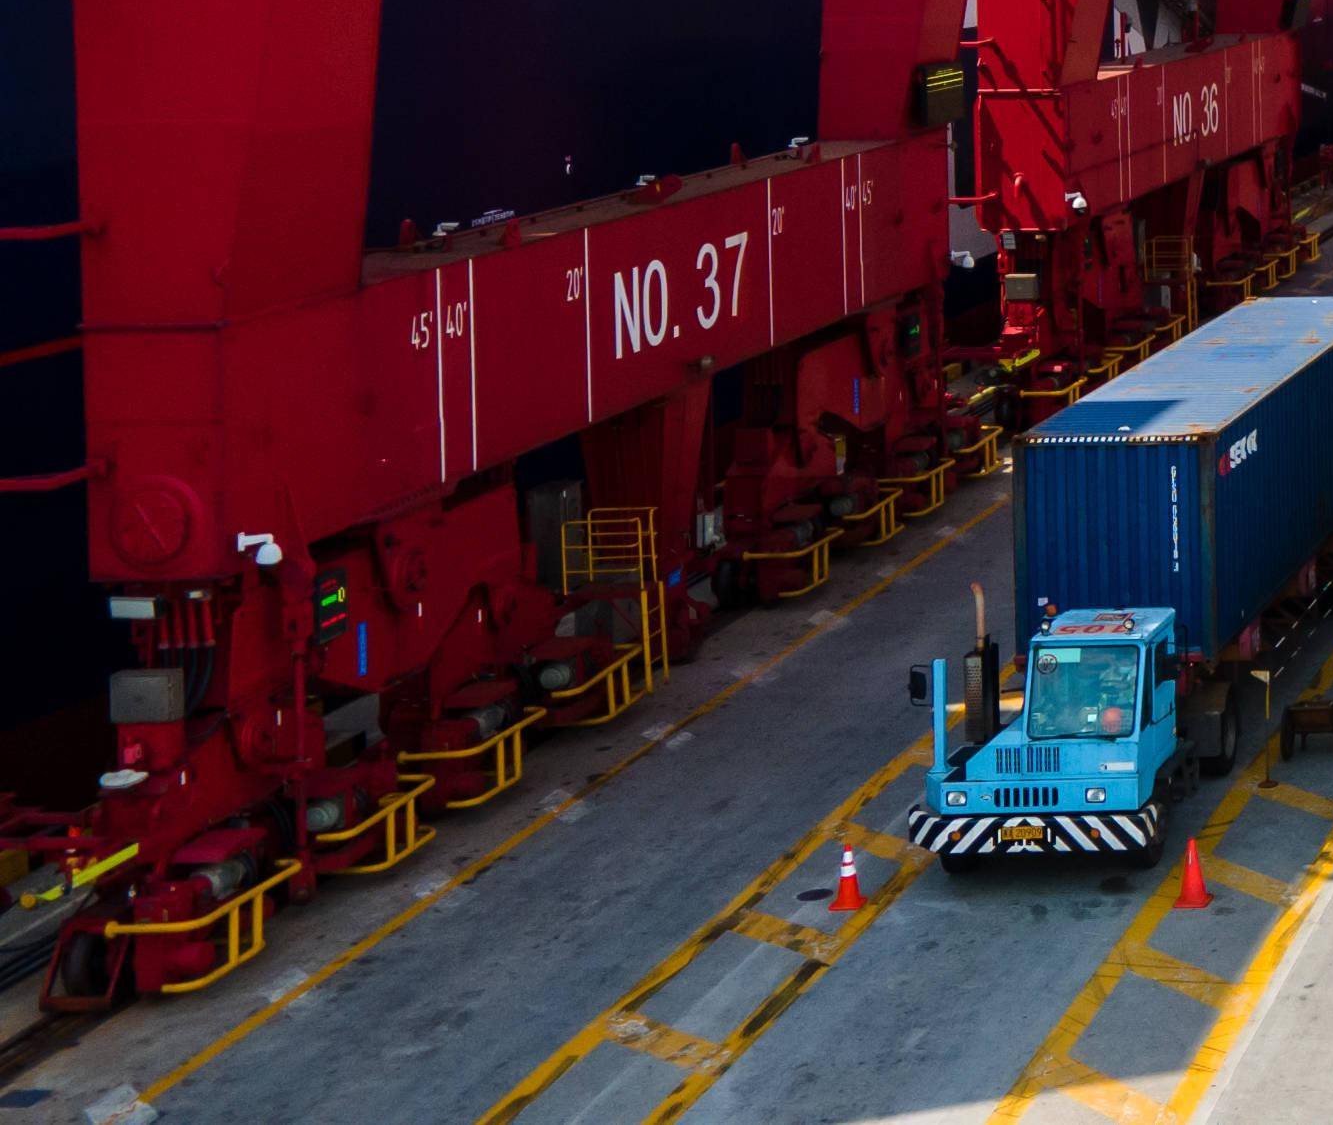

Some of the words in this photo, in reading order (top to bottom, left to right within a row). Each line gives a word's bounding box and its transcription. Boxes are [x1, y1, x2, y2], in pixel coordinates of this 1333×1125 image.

[1174, 91, 1197, 147] NO.
[1200, 82, 1219, 137] 36
[771, 206, 785, 236] 20'
[566, 266, 583, 302] 20'
[614, 259, 680, 360] NO.
[696, 231, 748, 330] 37
[411, 311, 433, 350] 45'
[445, 301, 467, 339] 40'
